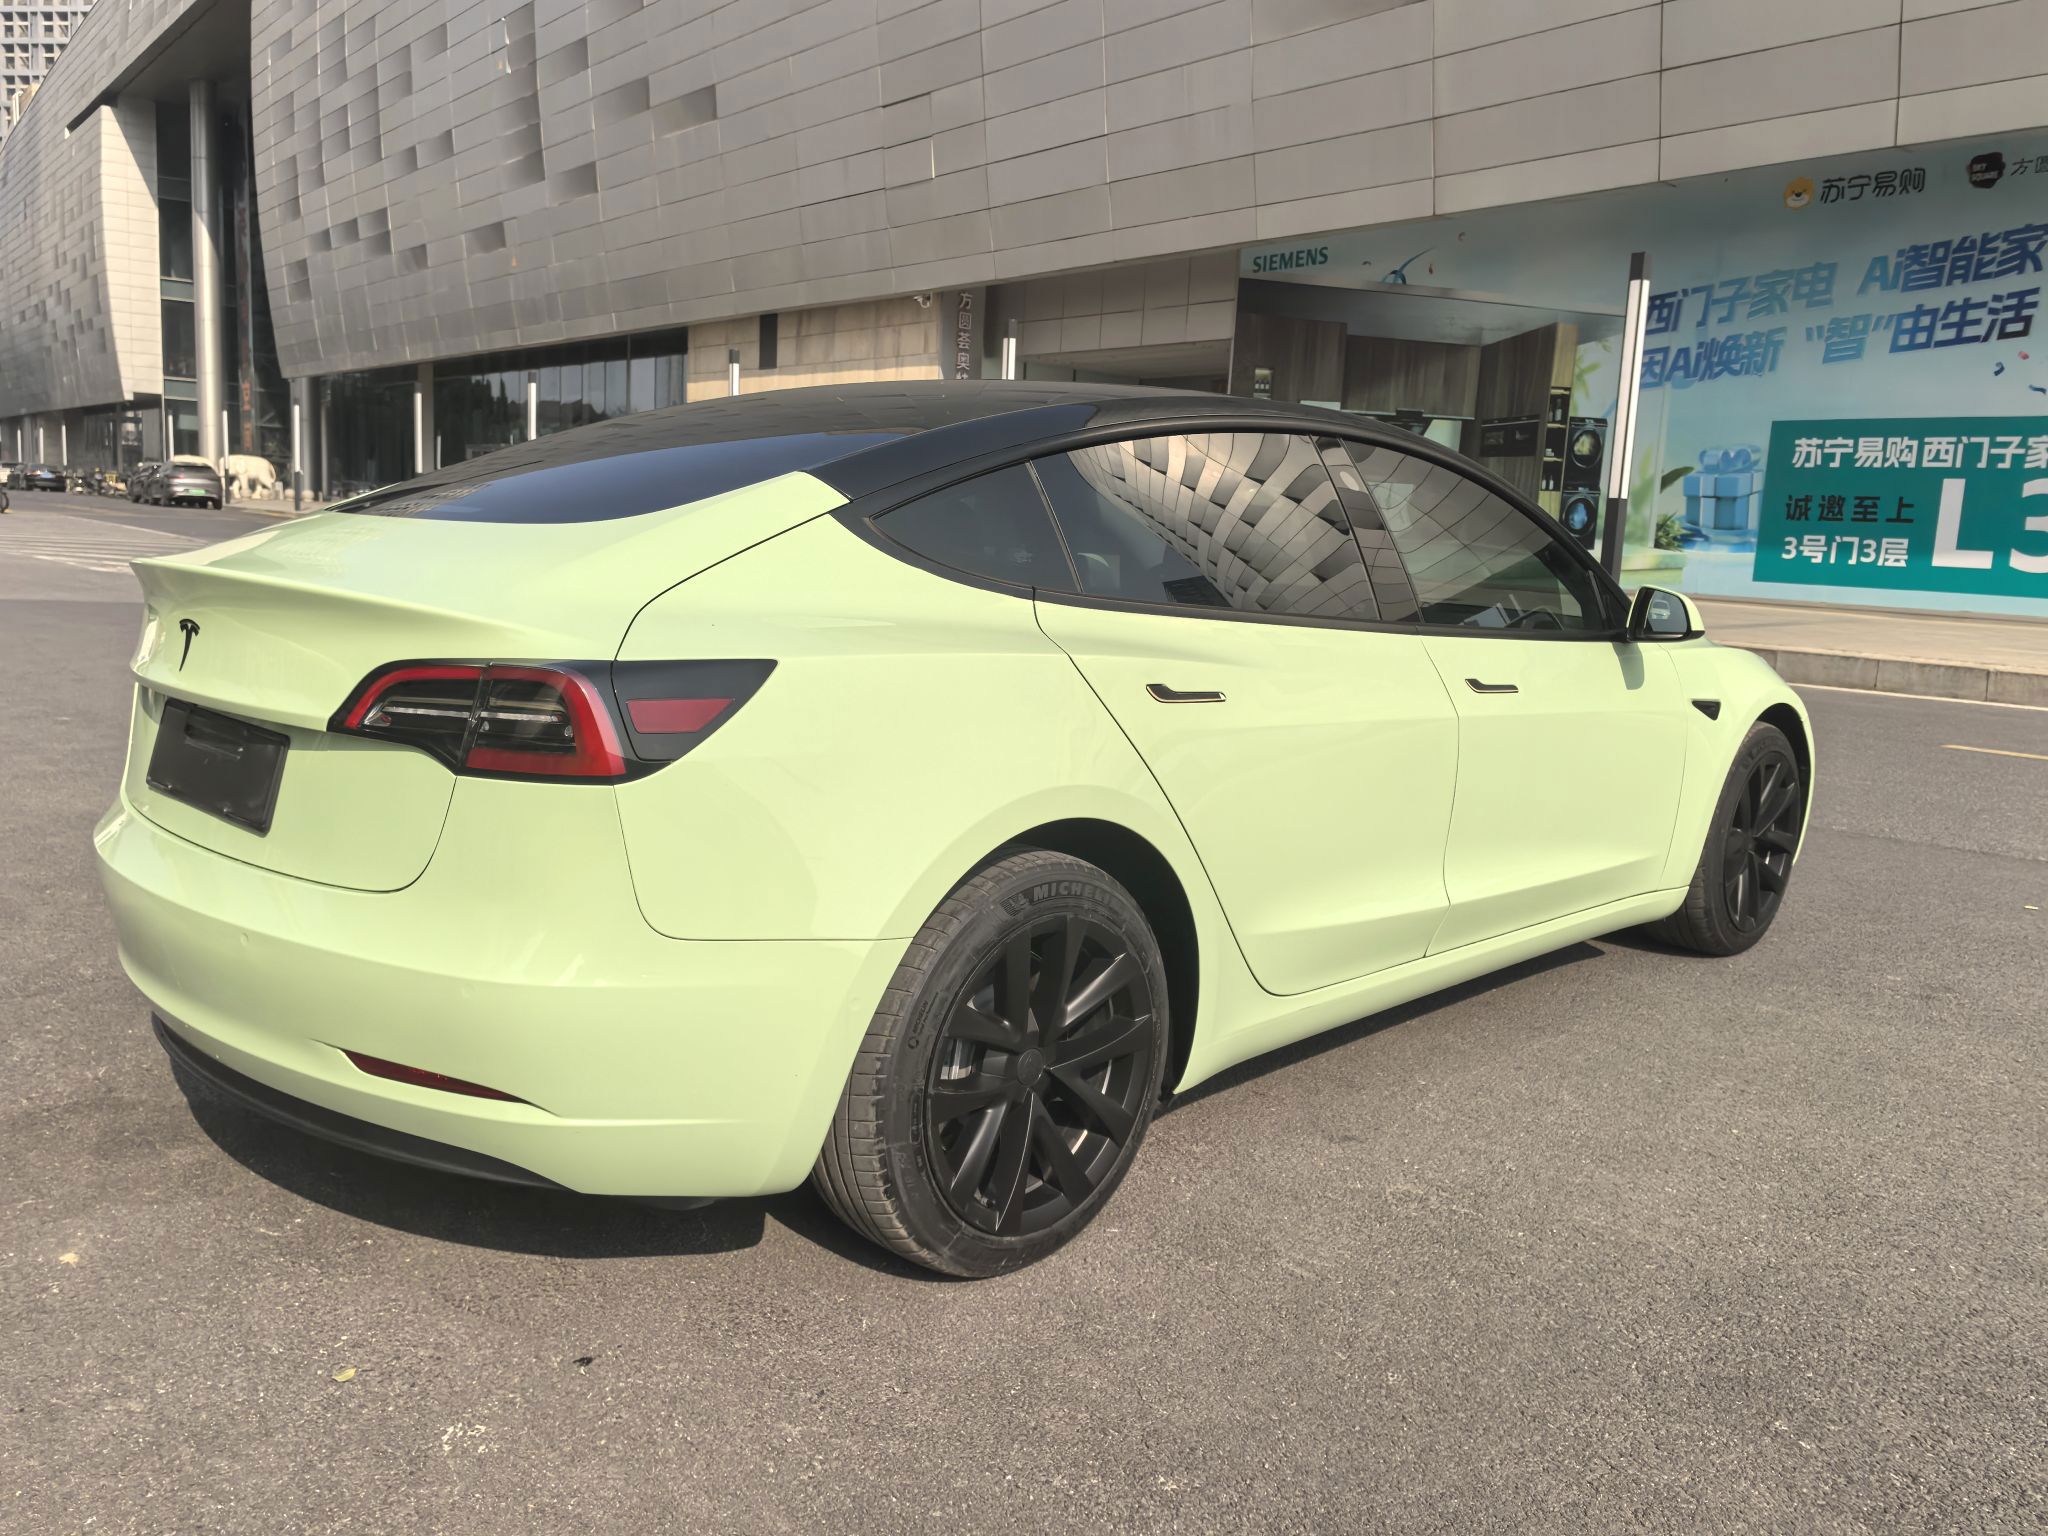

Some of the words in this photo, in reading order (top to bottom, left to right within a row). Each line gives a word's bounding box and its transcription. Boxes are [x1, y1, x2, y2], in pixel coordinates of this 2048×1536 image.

[1820, 167, 1926, 204] 苏宁易购
[1252, 246, 1329, 273] SIEMENS
[1645, 262, 1839, 335] 西门子家电
[1785, 495, 1915, 523] 诚邀至上
[1781, 534, 1909, 567] 3号门3层
